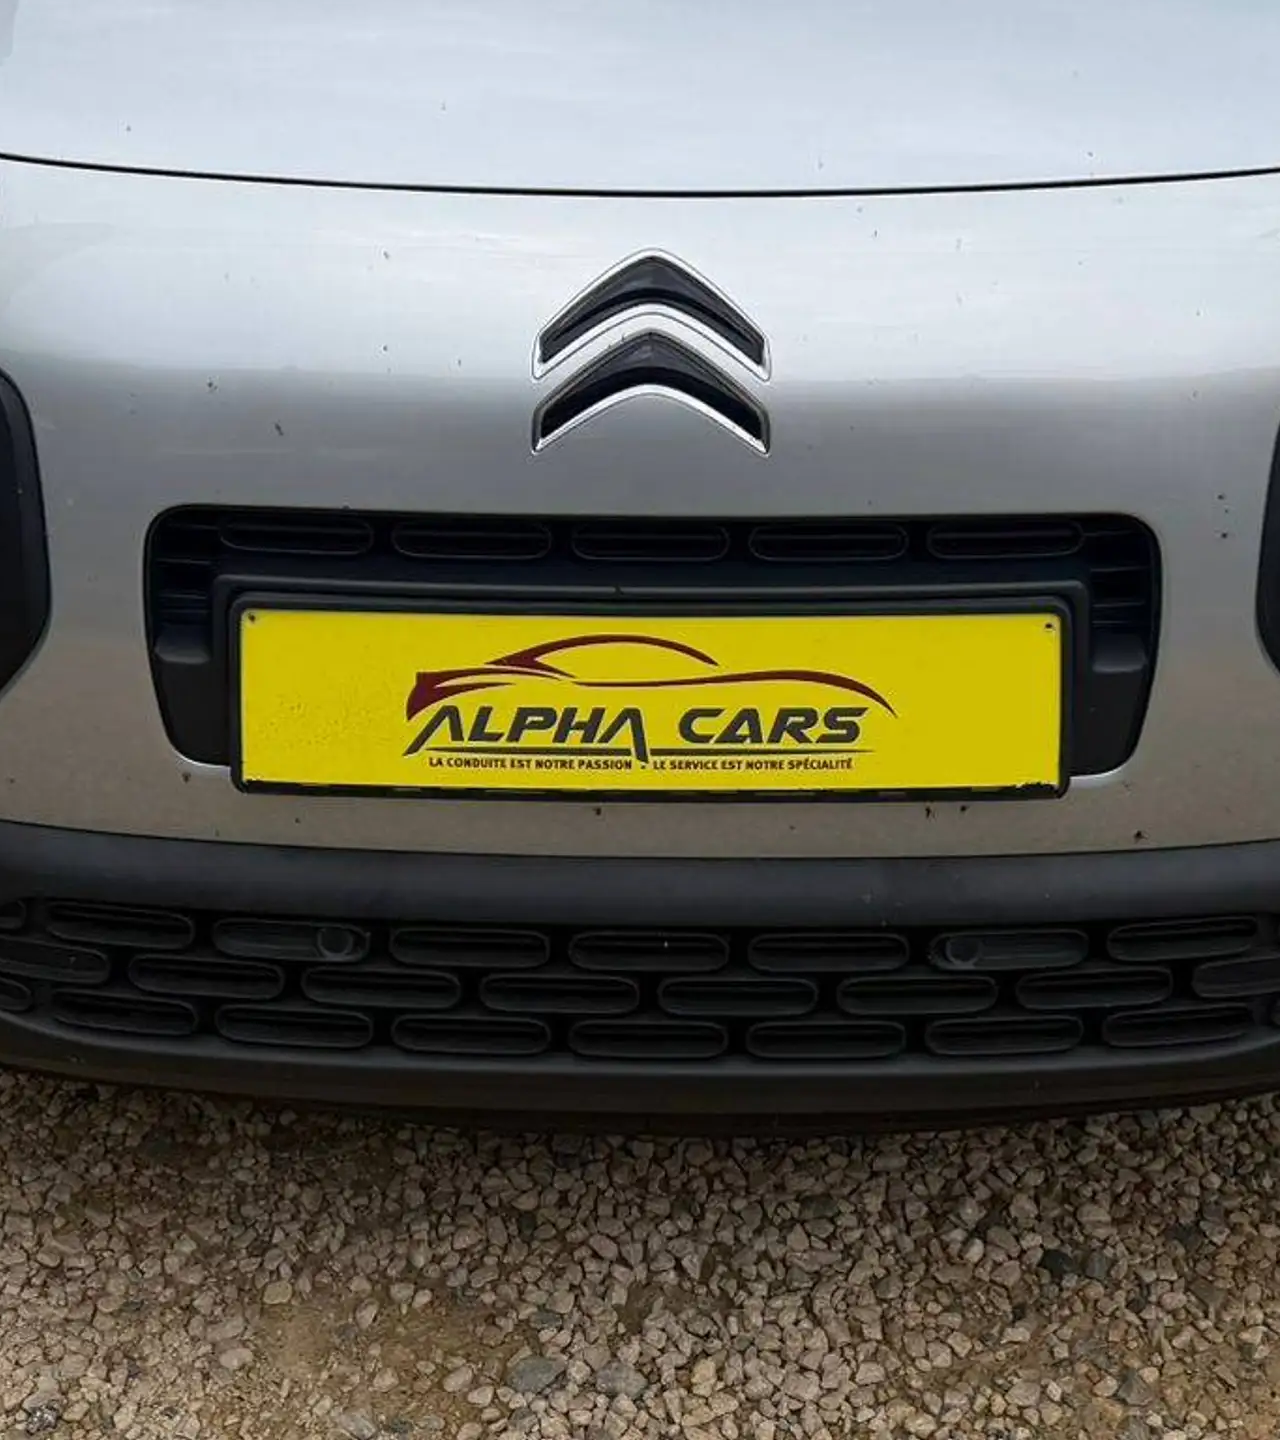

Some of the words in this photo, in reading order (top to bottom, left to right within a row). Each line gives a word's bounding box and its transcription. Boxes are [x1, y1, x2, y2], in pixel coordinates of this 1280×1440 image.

[403, 705, 648, 764] ALPHA
[678, 707, 869, 743] CARS
[428, 756, 444, 768] LA
[446, 757, 507, 768] CONDUITE
[510, 758, 531, 768] EST
[535, 758, 573, 769] NOTRE
[577, 759, 632, 770] PASSION
[653, 760, 667, 770] LE
[670, 760, 719, 770] SERVICE
[721, 760, 743, 770] EST
[747, 760, 785, 770] NOTRE
[788, 757, 853, 770] SPÉCIALITÉ
